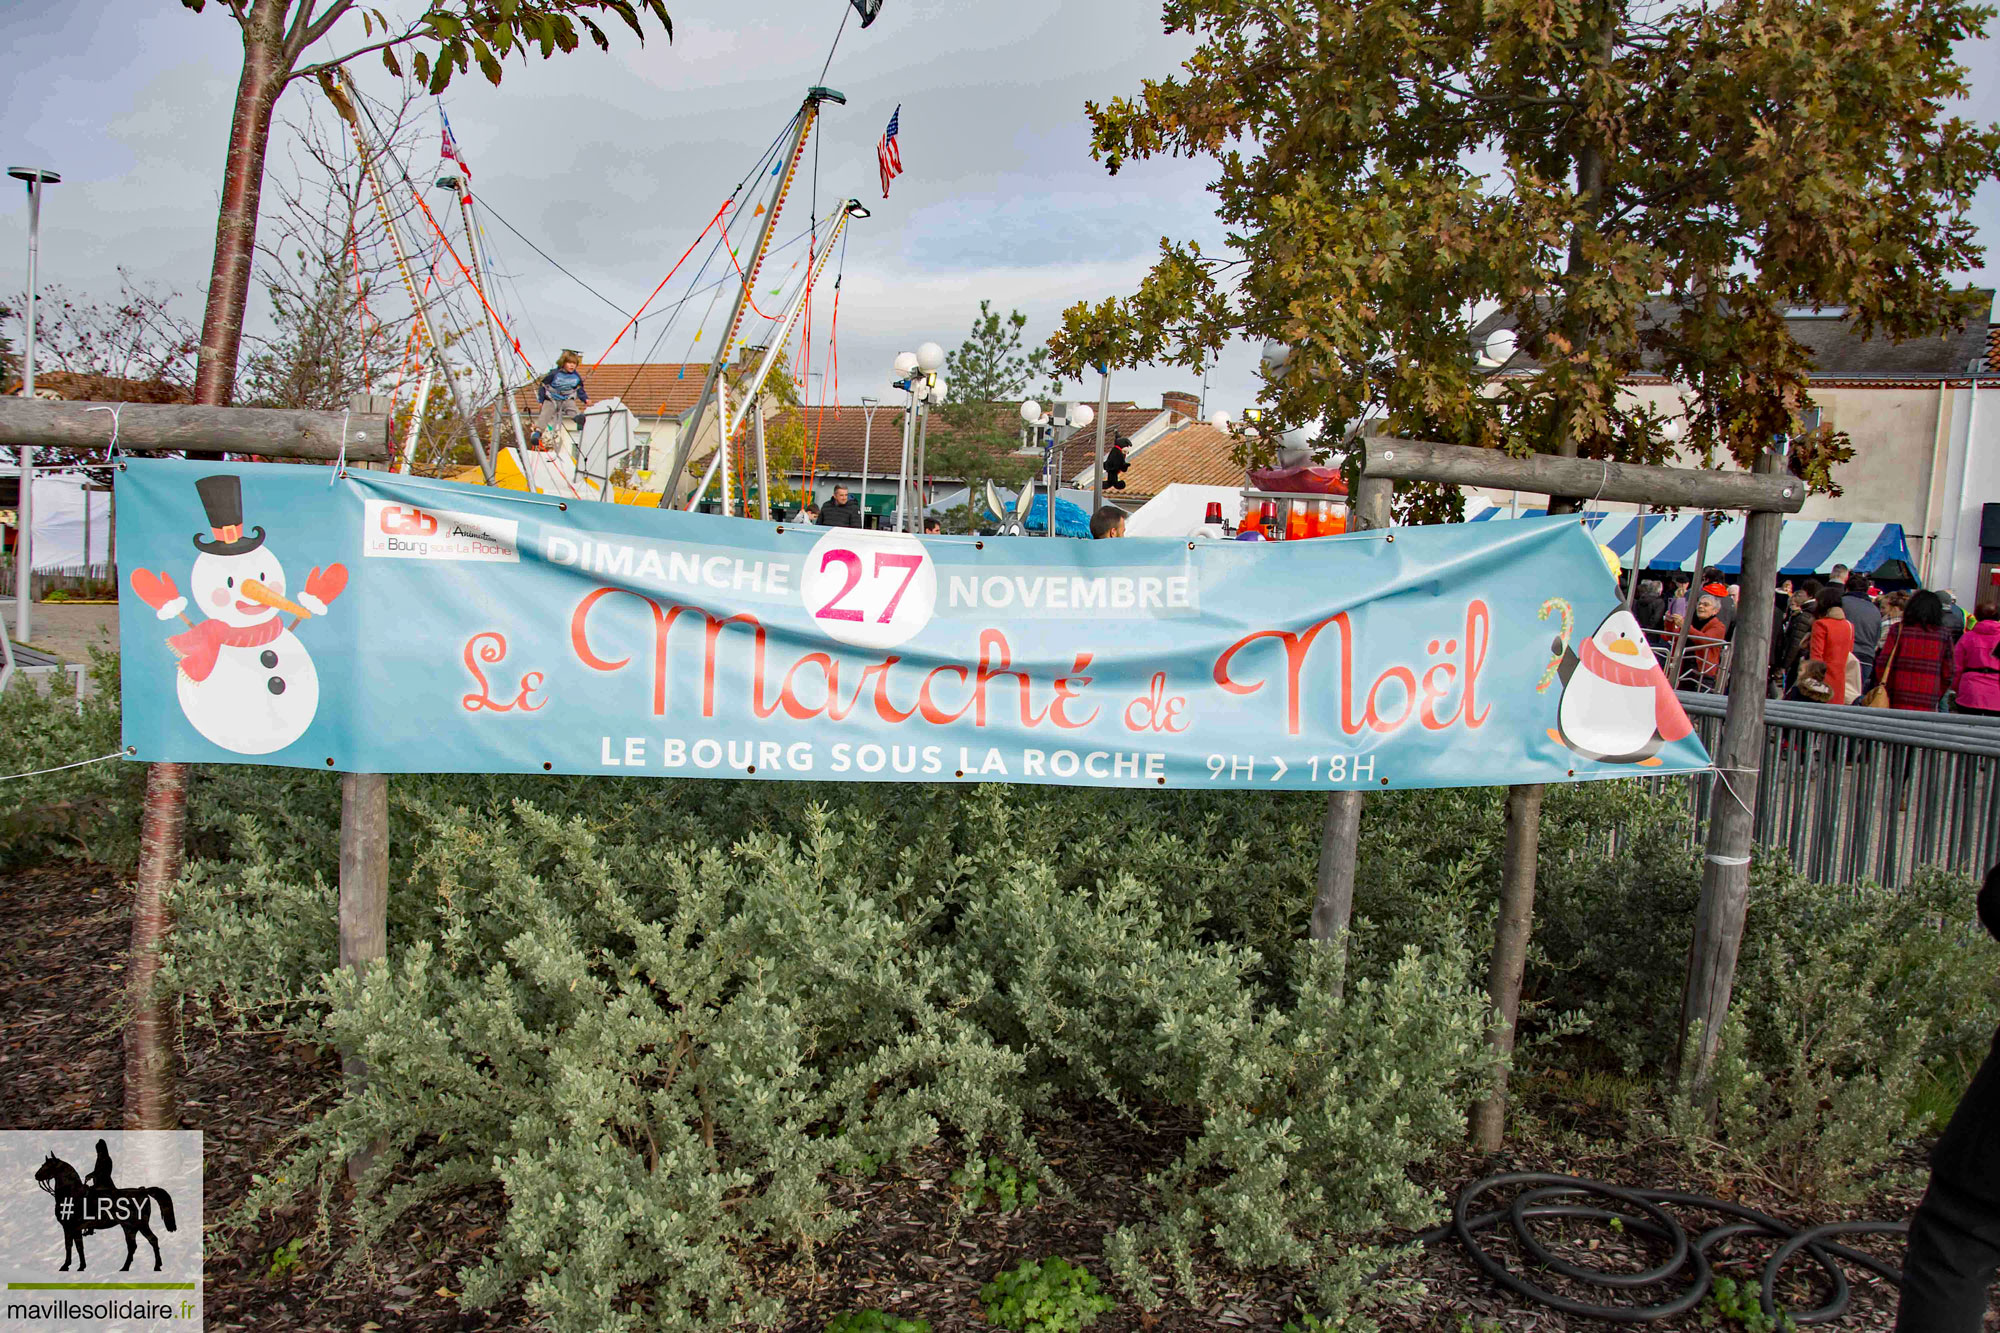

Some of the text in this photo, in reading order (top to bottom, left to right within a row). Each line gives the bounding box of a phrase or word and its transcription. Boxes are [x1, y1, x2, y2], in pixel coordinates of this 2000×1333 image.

[372, 540, 385, 550] Le
[388, 537, 427, 555] Bourg
[456, 543, 470, 553] La
[472, 541, 512, 556] Roche
[545, 536, 1190, 624] DIMANCHE 27 NOVEMBRE
[462, 586, 1492, 735] Le Marché de Noël
[600, 736, 1167, 779] LE BOURG SOUS LA ROCHE
[1206, 753, 1376, 781] 9H 18H
